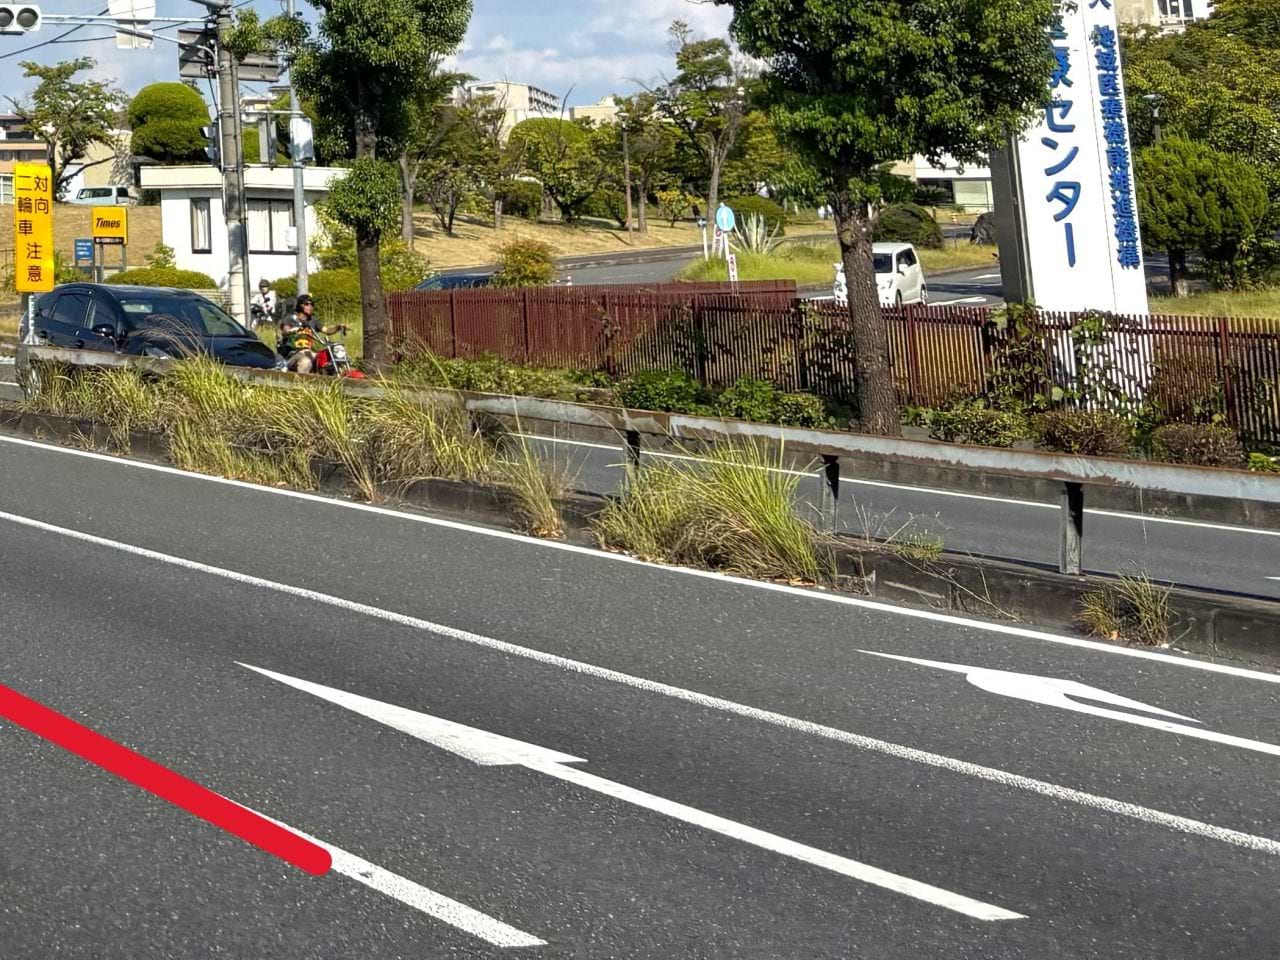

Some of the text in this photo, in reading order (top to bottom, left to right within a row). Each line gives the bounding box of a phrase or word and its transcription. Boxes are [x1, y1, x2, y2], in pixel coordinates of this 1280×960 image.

[17, 175, 33, 236] 二輪車
[33, 175, 48, 215] 対向
[96, 217, 121, 228] Times
[26, 242, 42, 283] 注意
